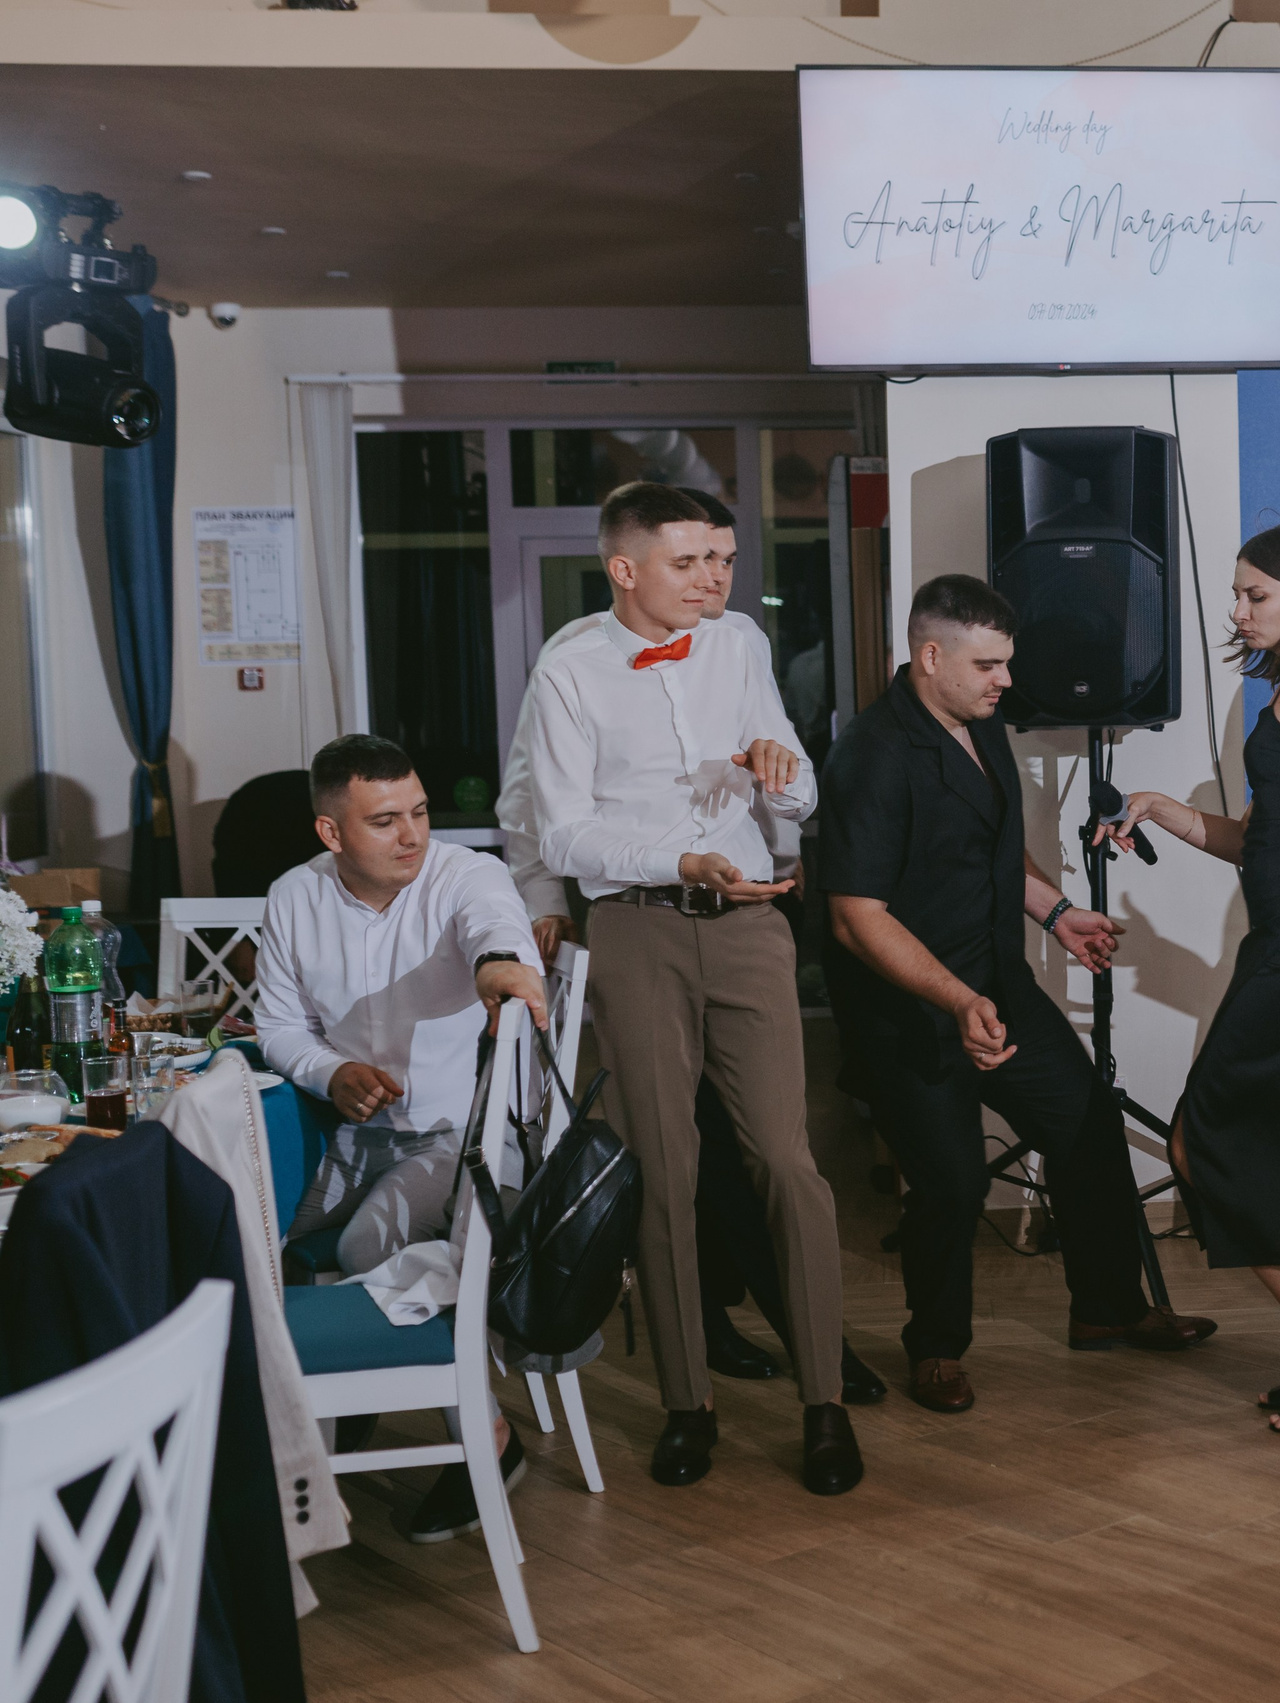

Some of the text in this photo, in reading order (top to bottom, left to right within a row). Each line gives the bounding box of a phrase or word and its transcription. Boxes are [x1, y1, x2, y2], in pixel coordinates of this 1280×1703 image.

[997, 107, 1113, 155] Wedding day
[1019, 205, 1042, 240] &
[1059, 182, 1278, 276] Margarita
[195, 510, 295, 521] ПЛАН ЭВАКУАЦИИ
